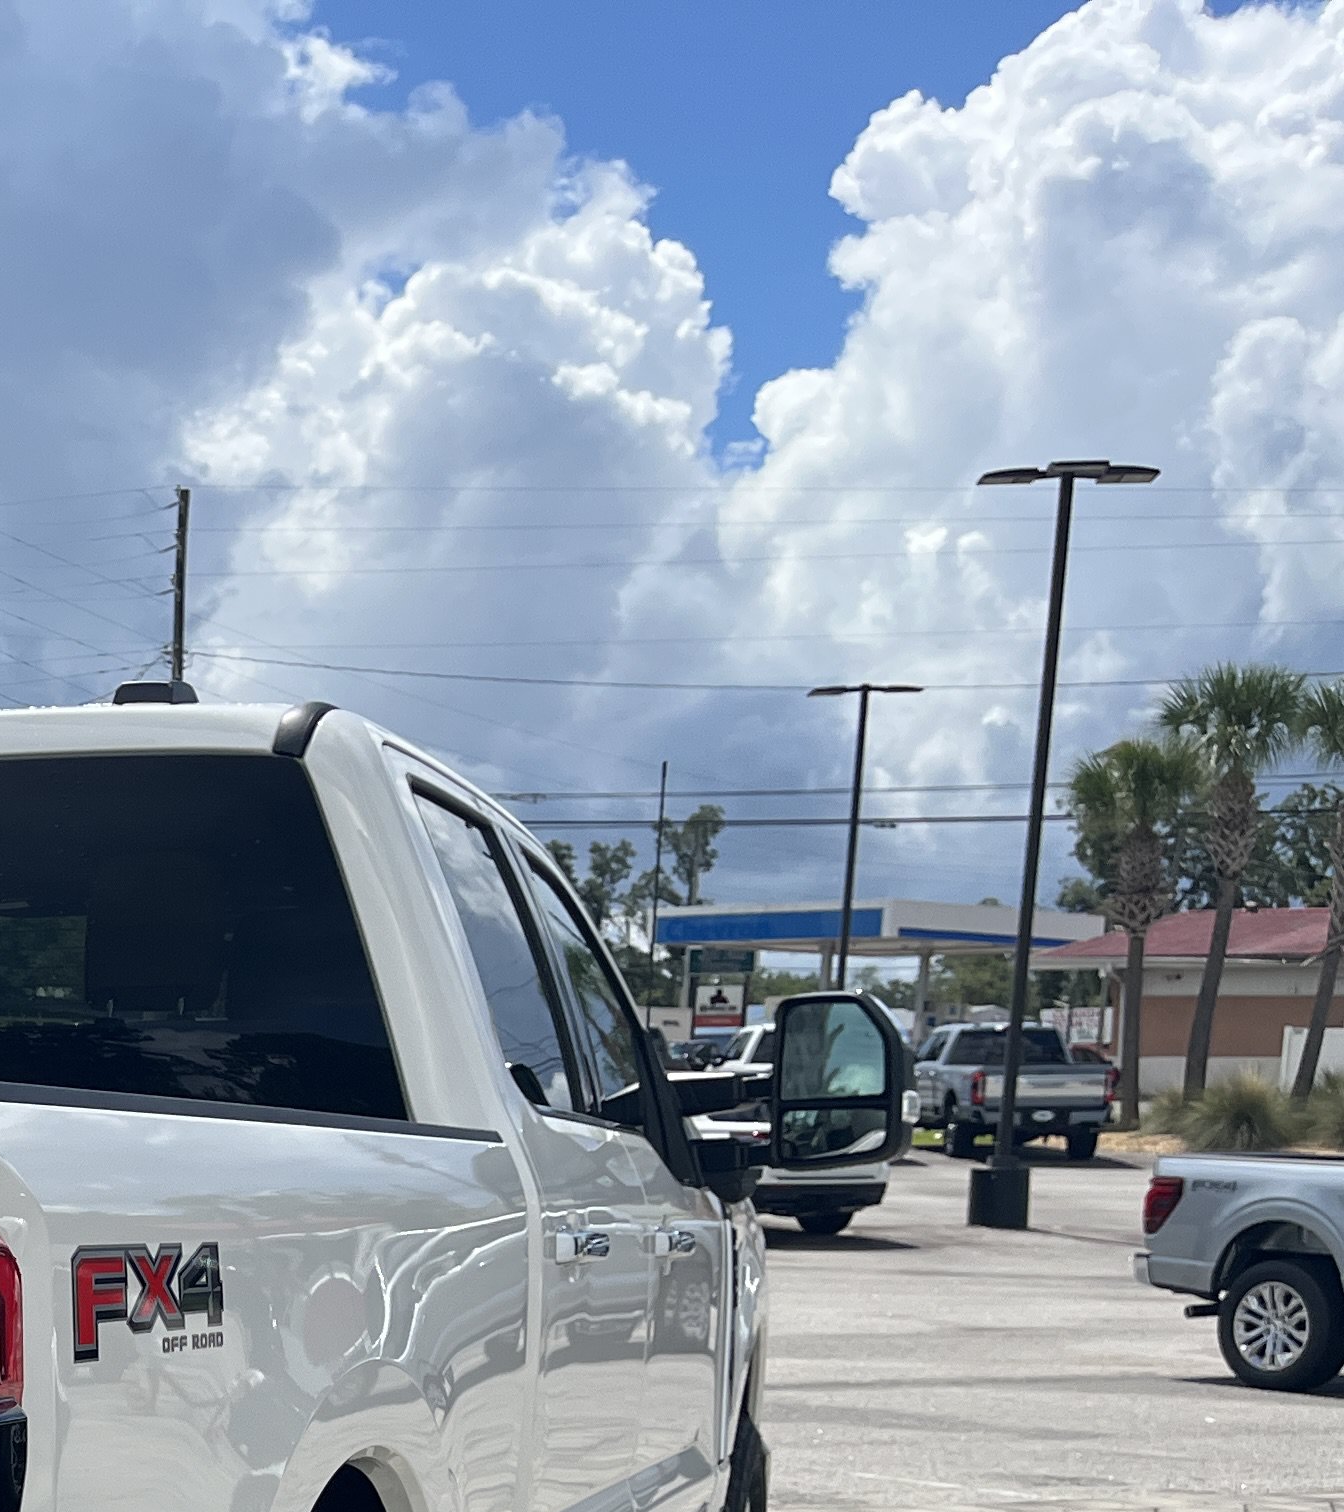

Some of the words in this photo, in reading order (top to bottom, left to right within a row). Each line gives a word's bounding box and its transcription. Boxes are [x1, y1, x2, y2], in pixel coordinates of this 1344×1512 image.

[70, 1241, 224, 1364] FX4
[162, 1335, 188, 1354] OFF
[191, 1331, 224, 1350] ROAD
